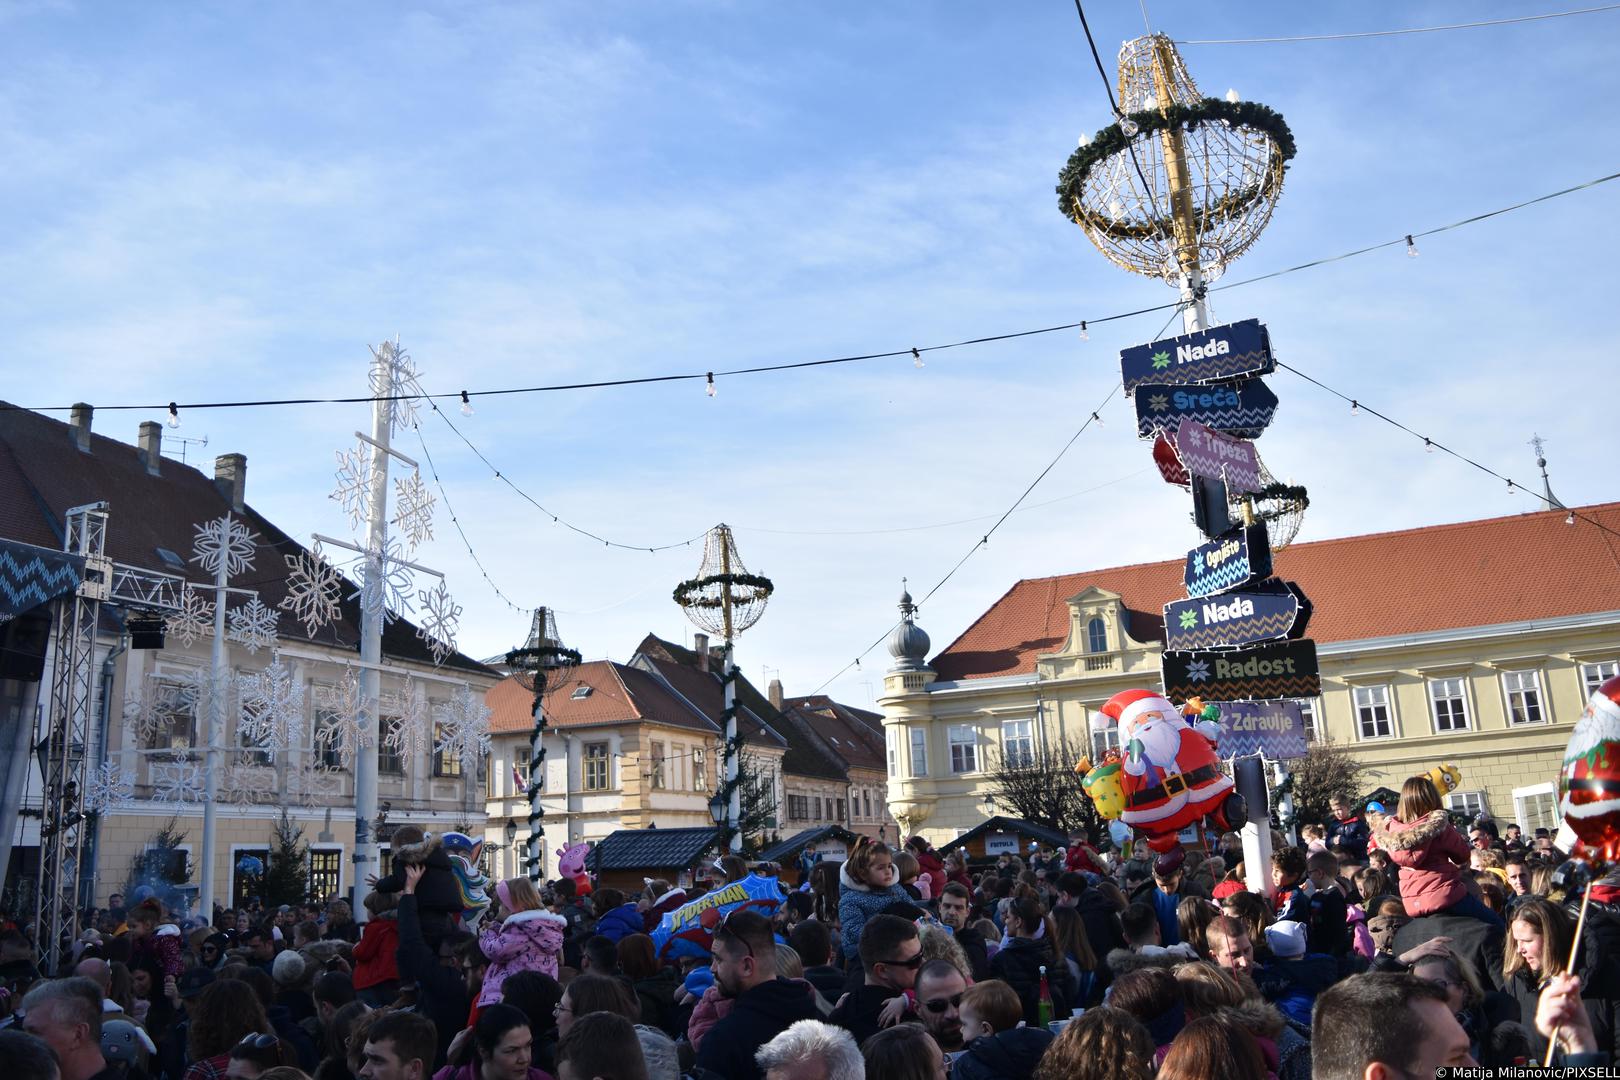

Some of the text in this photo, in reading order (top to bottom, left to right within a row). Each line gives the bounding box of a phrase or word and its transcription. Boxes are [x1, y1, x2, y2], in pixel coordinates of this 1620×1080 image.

[1176, 338, 1230, 364] Nada
[1173, 388, 1238, 409] Sreća
[1203, 431, 1249, 463] Trpeza
[1206, 539, 1240, 568] Ognjište
[1202, 596, 1254, 625] Nada
[1215, 656, 1296, 679] Radost
[1231, 712, 1293, 734] Zdravlje
[671, 884, 750, 933] SPIDER-MAN
